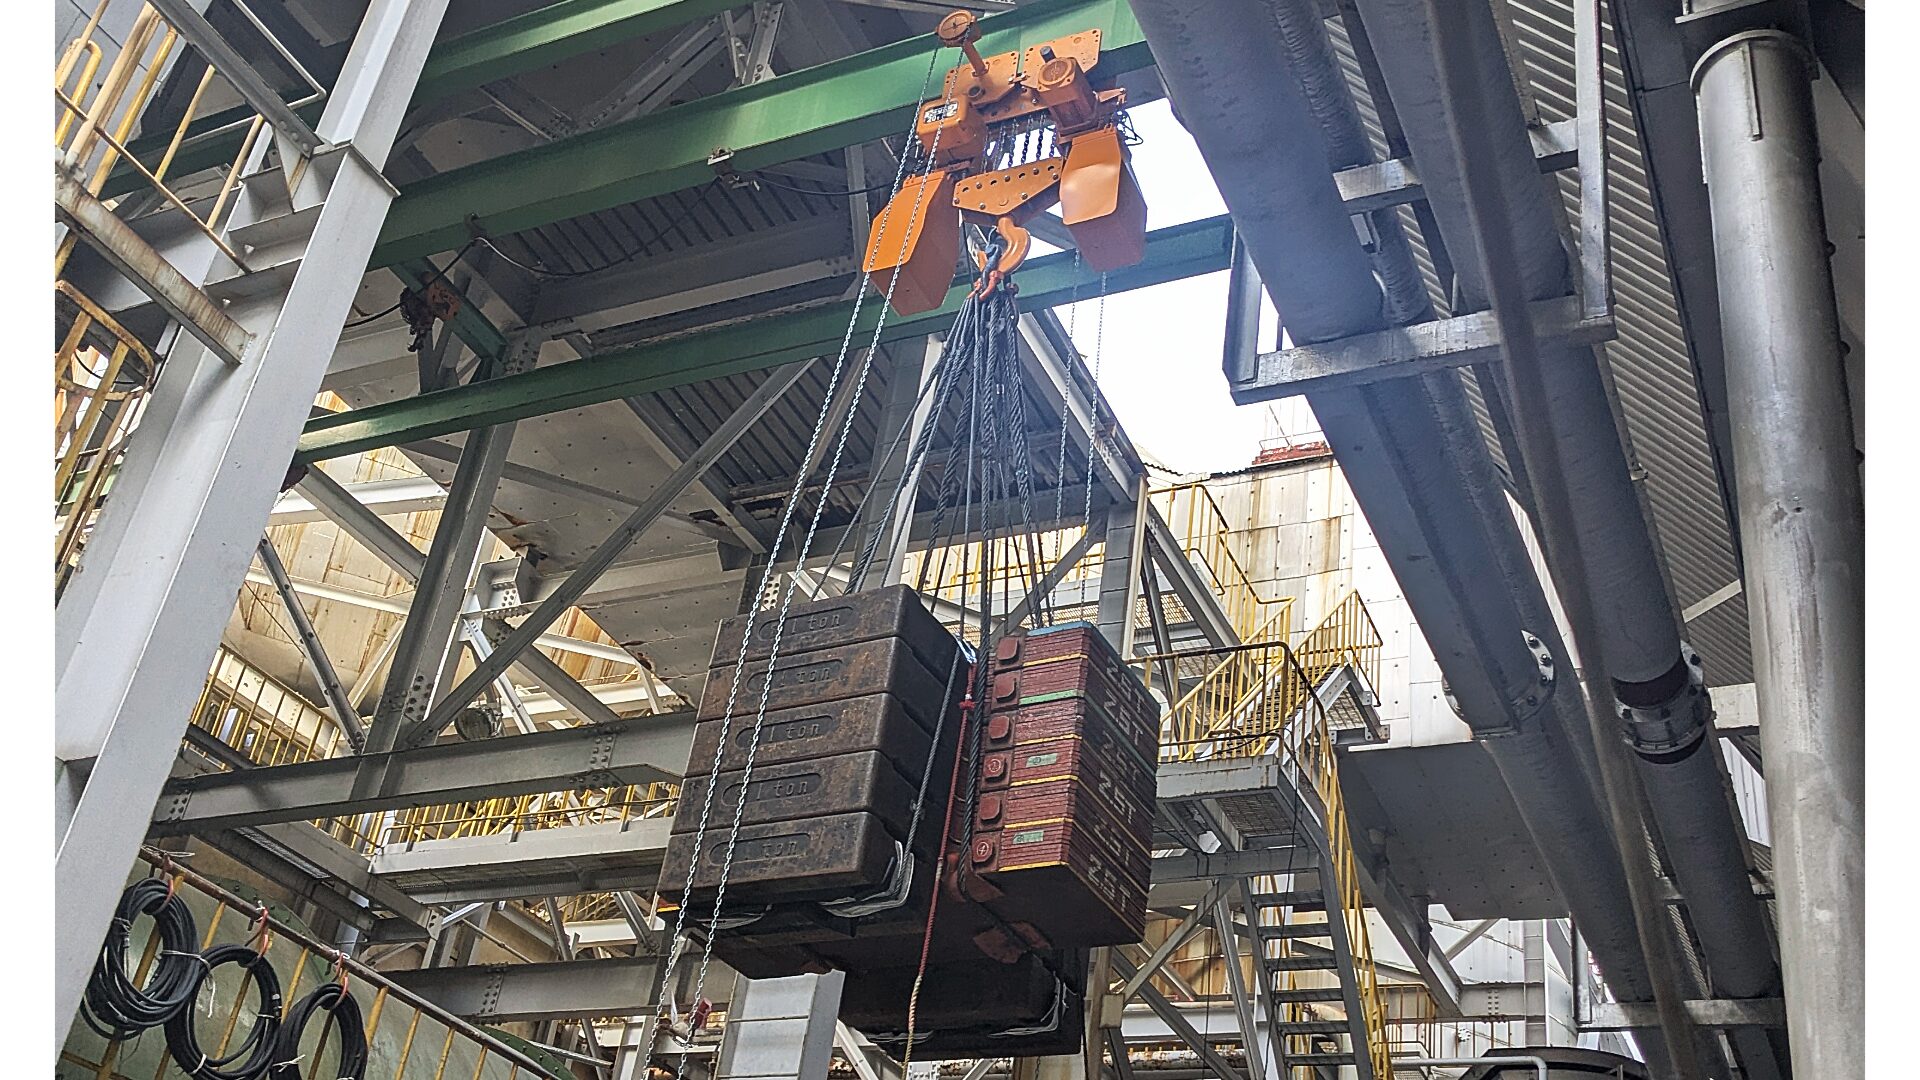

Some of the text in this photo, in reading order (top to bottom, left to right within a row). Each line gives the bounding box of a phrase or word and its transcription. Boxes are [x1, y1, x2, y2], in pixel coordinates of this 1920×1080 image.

[808, 613, 840, 632] ton
[797, 667, 831, 684] ton
[785, 723, 820, 739] ton
[773, 780, 808, 798] ton
[1098, 769, 1137, 824] 2.5T
[762, 841, 797, 858] ton
